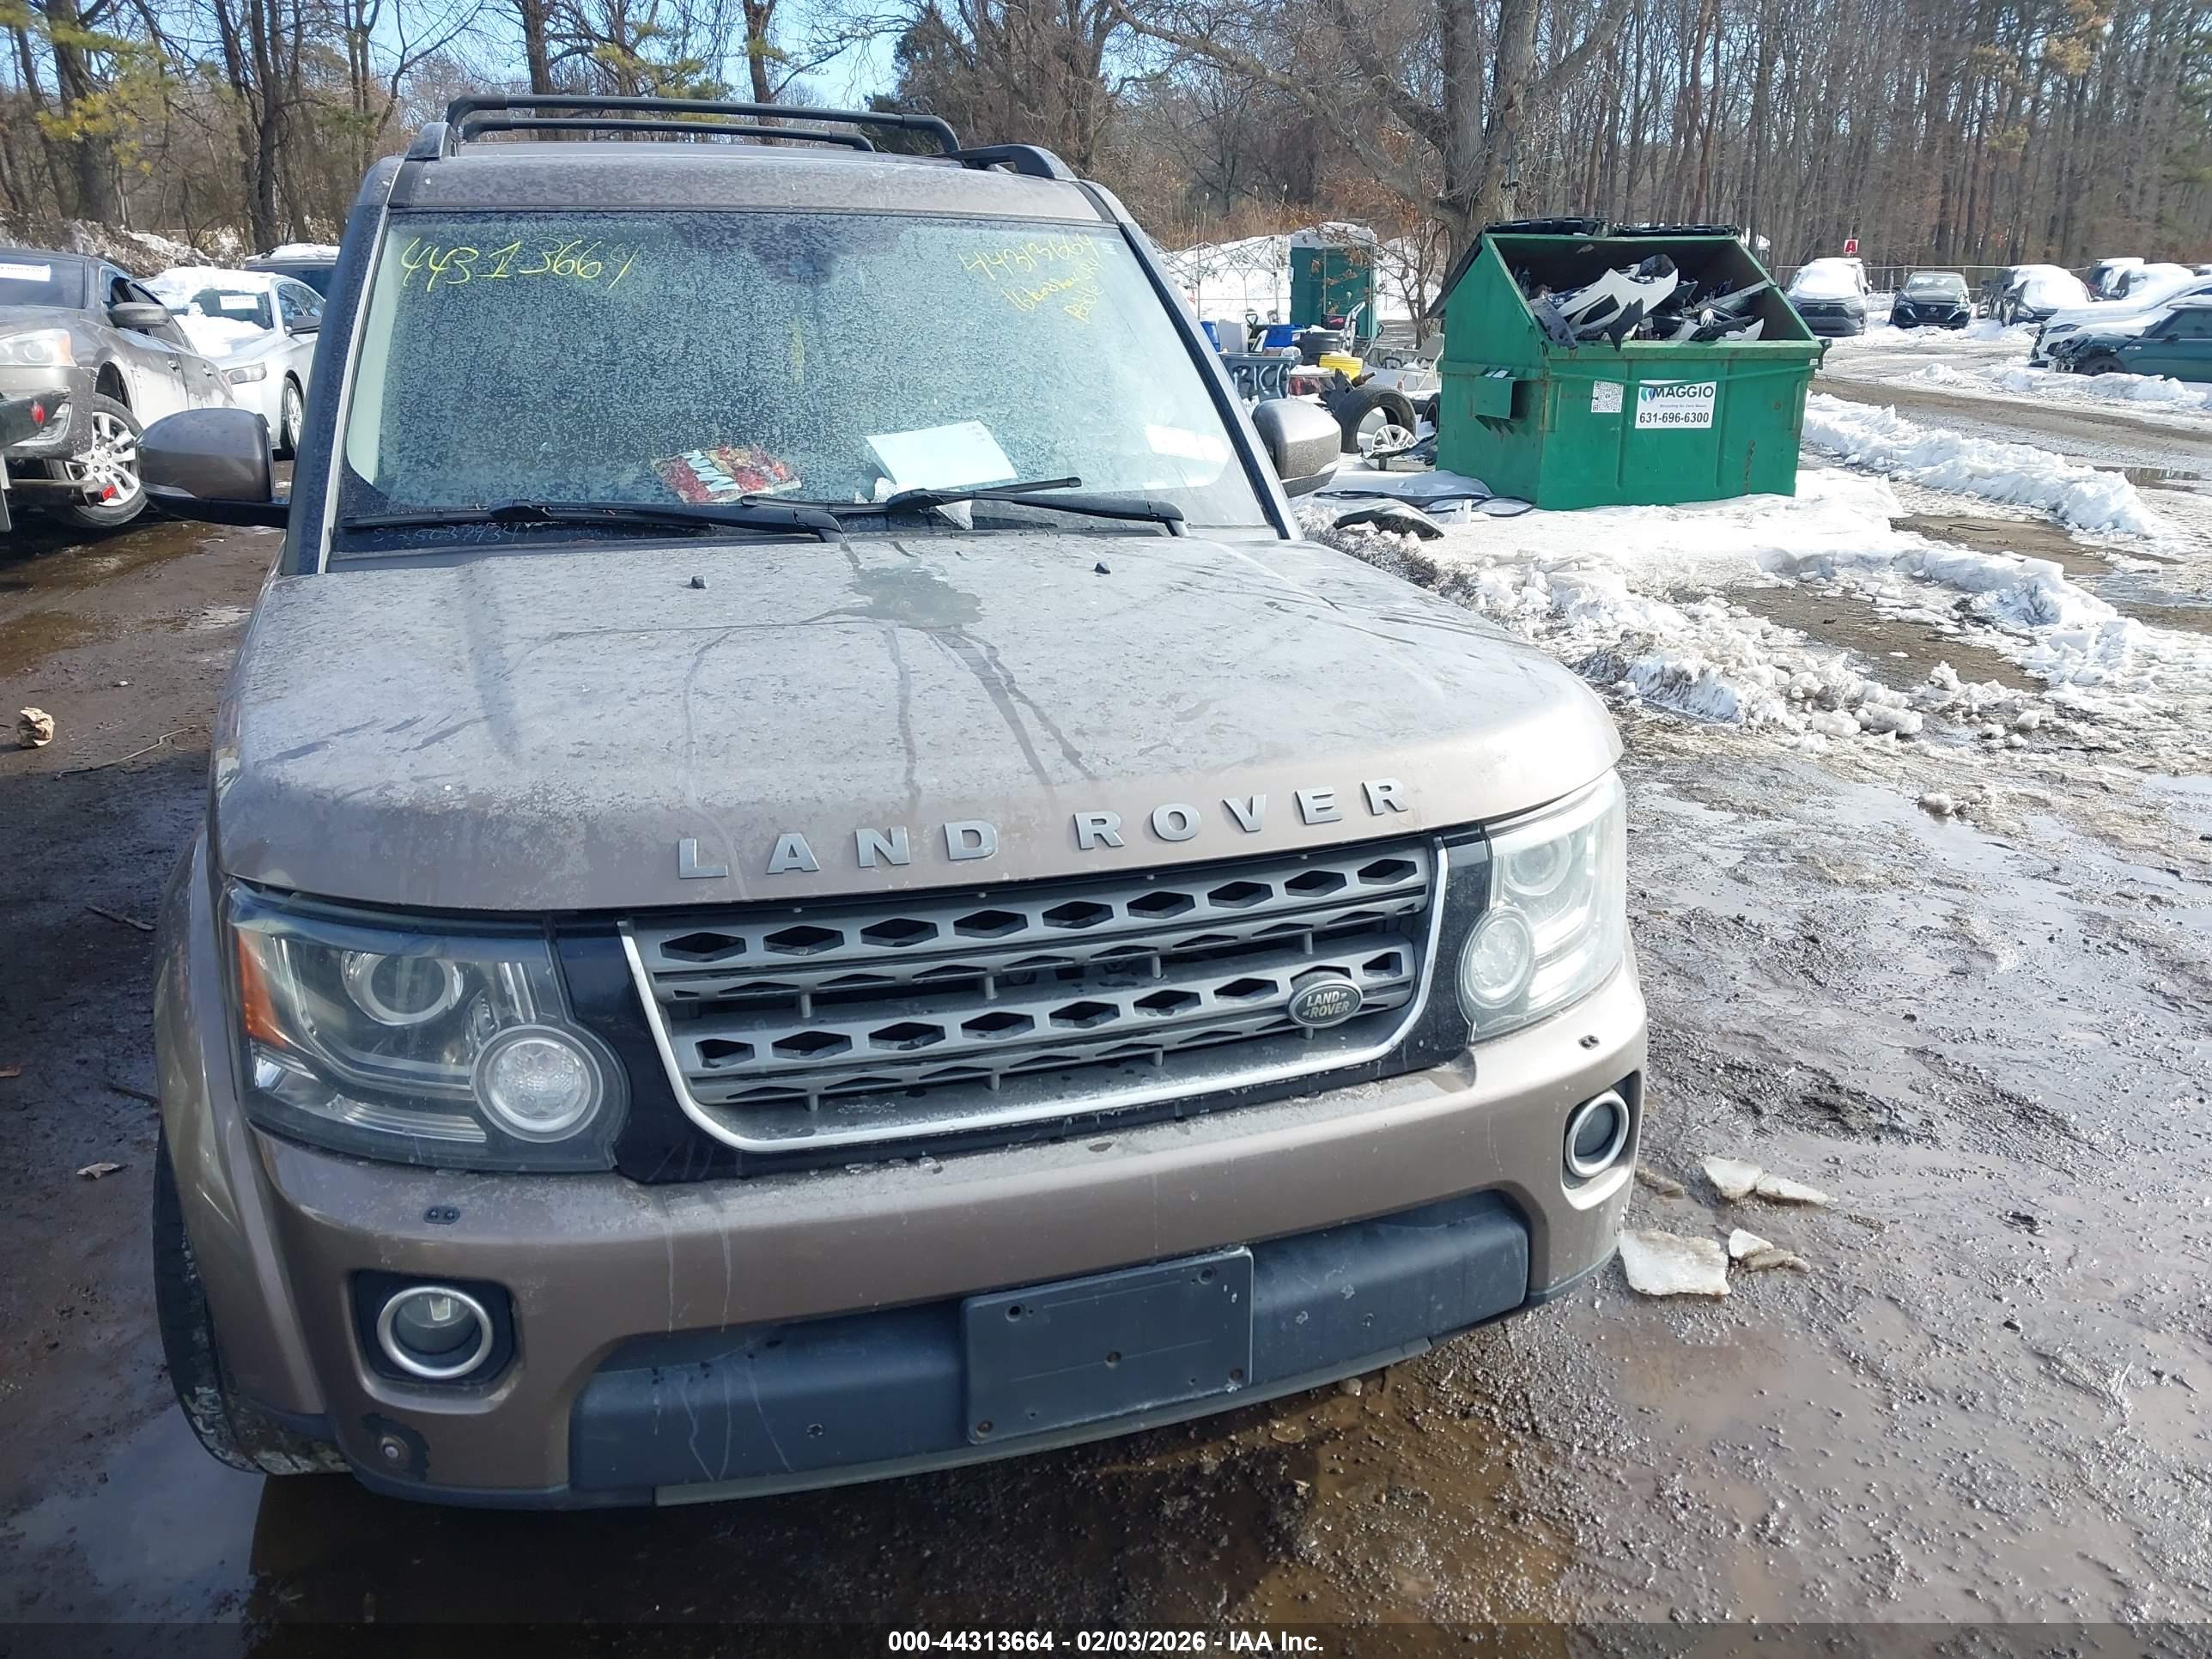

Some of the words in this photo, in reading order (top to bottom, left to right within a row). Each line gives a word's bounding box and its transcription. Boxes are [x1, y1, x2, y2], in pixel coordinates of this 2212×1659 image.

[1845, 240, 1856, 252] A
[1654, 386, 1714, 398] MAGGIO
[1639, 412, 1710, 423] 631-696-6300
[678, 819, 1000, 879] LAND
[1073, 777, 1409, 850] ROVER
[1306, 990, 1340, 1007] LAND
[1310, 1000, 1351, 1018] ROVER
